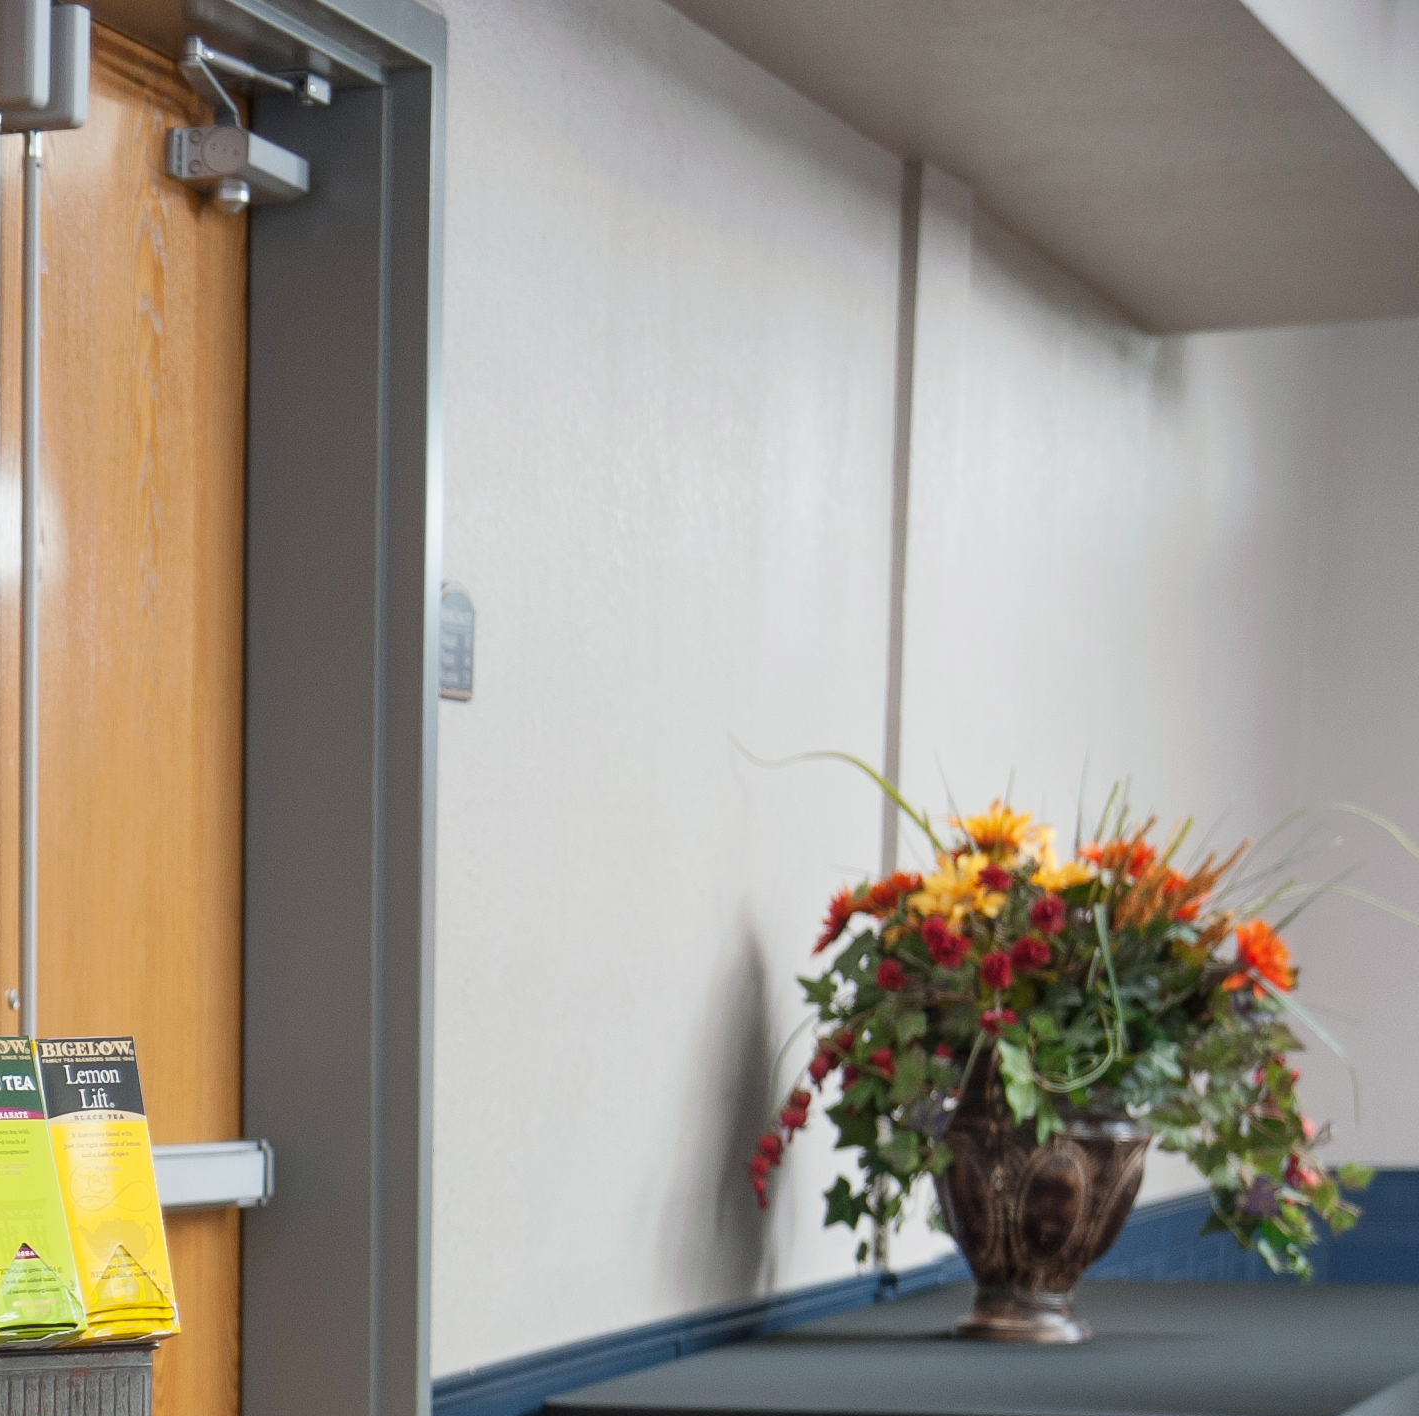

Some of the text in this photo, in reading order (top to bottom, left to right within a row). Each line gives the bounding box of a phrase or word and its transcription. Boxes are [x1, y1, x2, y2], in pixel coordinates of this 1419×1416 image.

[39, 1041, 133, 1057] BIGELOW
[2, 1075, 36, 1091] TEA
[63, 1064, 121, 1085] Lemon
[78, 1088, 109, 1109] Lift
